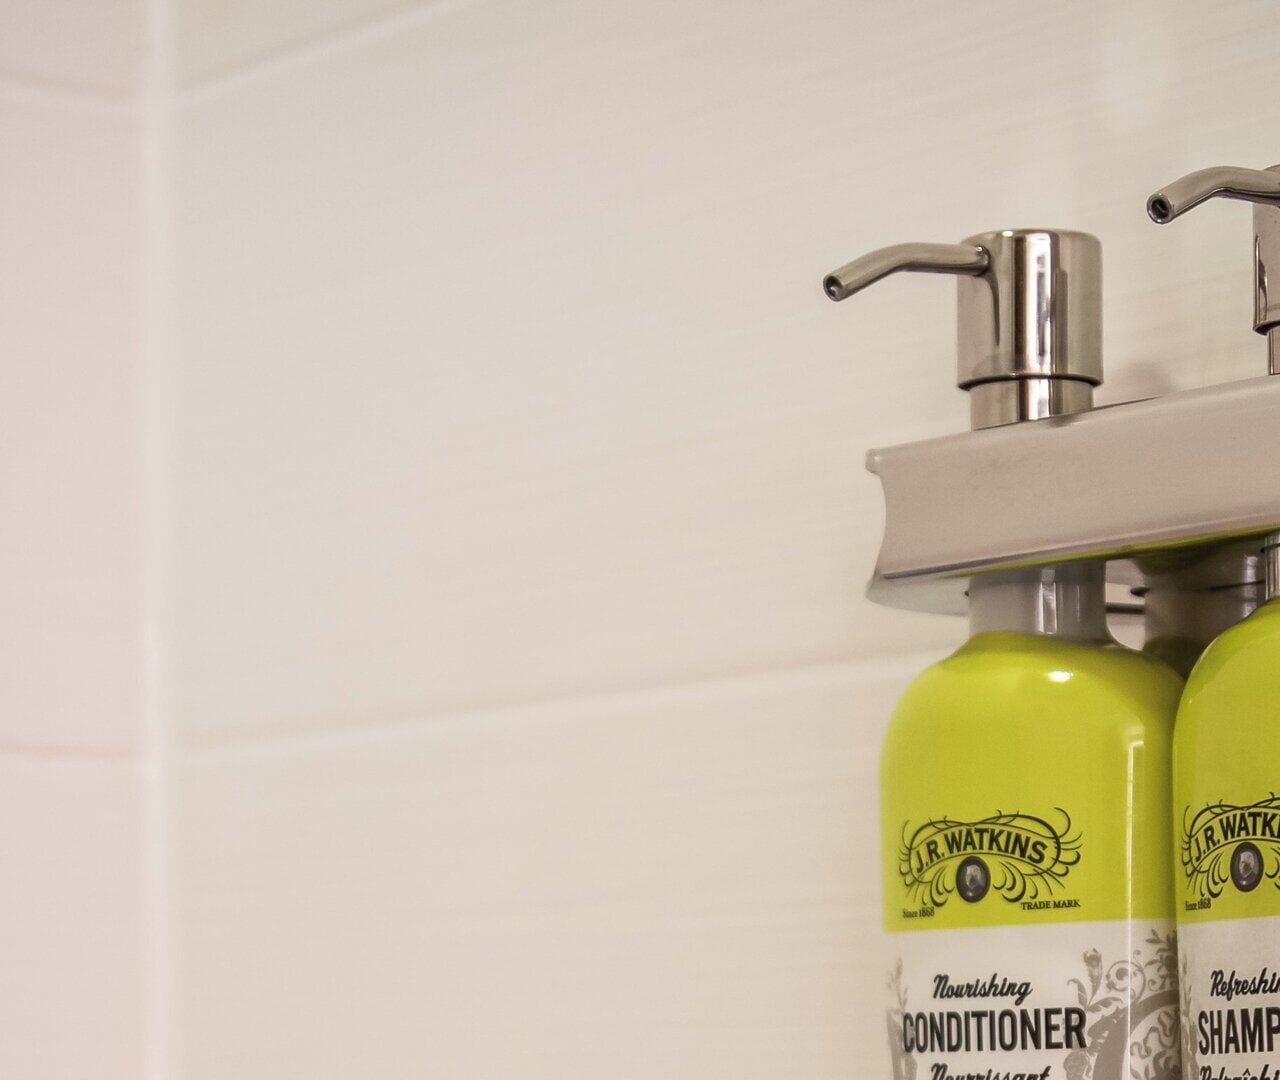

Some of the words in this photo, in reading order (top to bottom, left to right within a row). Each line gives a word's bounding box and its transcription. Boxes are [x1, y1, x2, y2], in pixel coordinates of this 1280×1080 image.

[945, 827, 1048, 864] WATKINS
[1021, 901, 1051, 910] TRADE
[1053, 899, 1080, 908] MARK
[932, 973, 1032, 1006] Nourishing
[903, 1006, 1087, 1053] CONDITIONER
